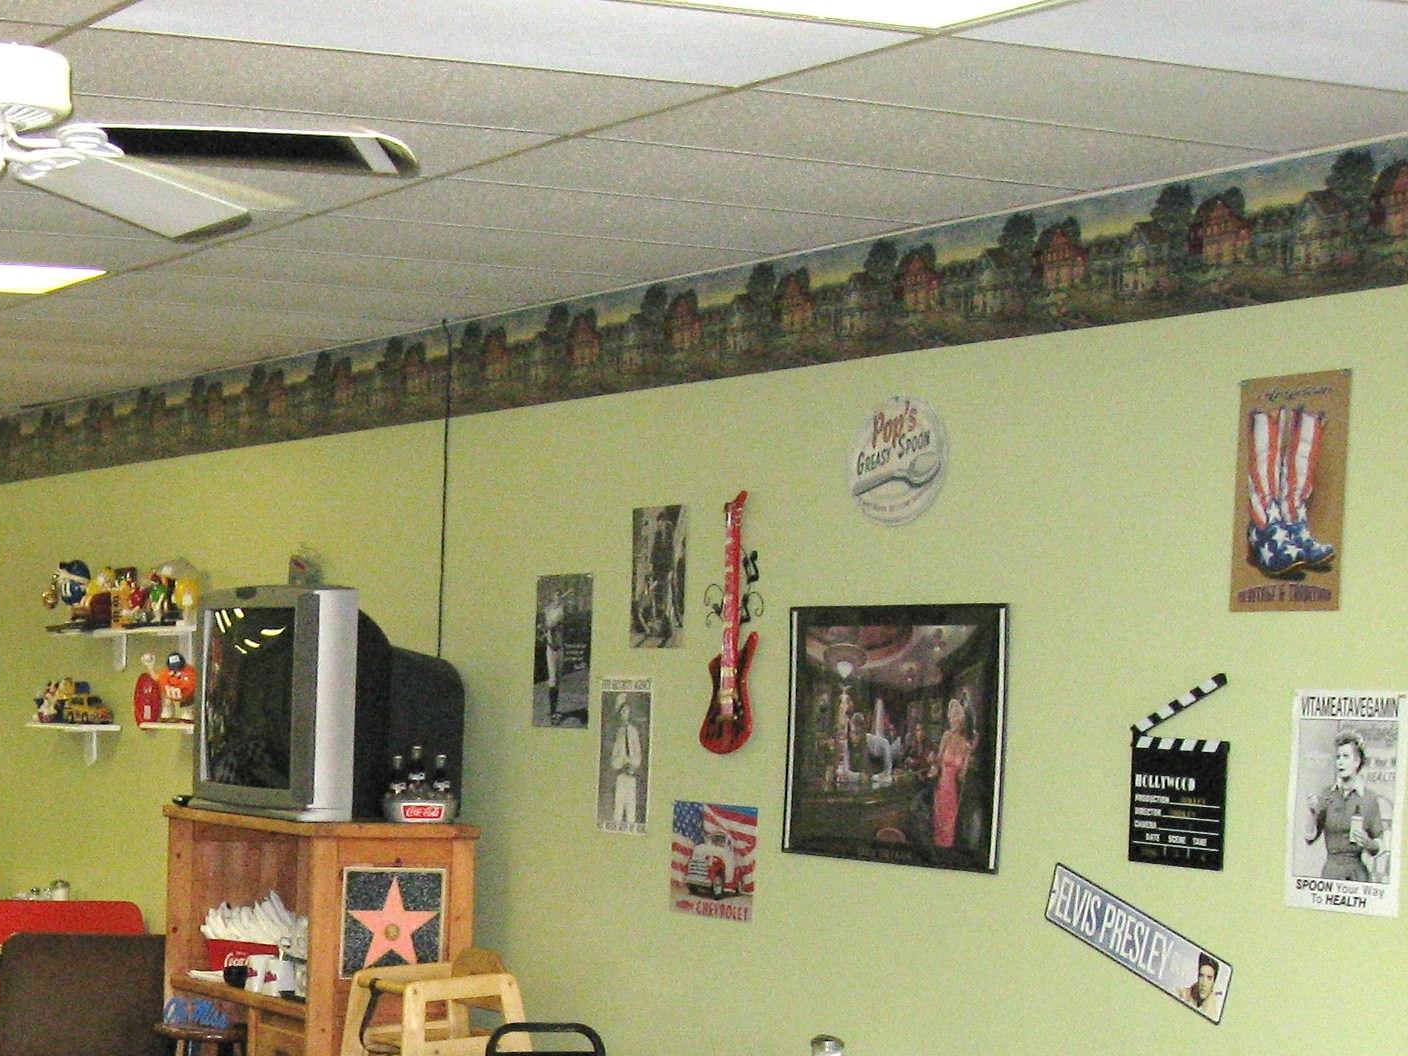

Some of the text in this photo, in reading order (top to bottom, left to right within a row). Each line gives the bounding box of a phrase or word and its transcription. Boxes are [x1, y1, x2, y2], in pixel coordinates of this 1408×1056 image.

[1301, 695, 1399, 718] VITAMEATAVEGAMIN
[1135, 773, 1196, 792] HOLLYWOOD
[1295, 878, 1386, 900] SPOON Your Way
[1324, 894, 1368, 909] HEALTH
[1055, 876, 1174, 981] ELVIS PRESLEY
